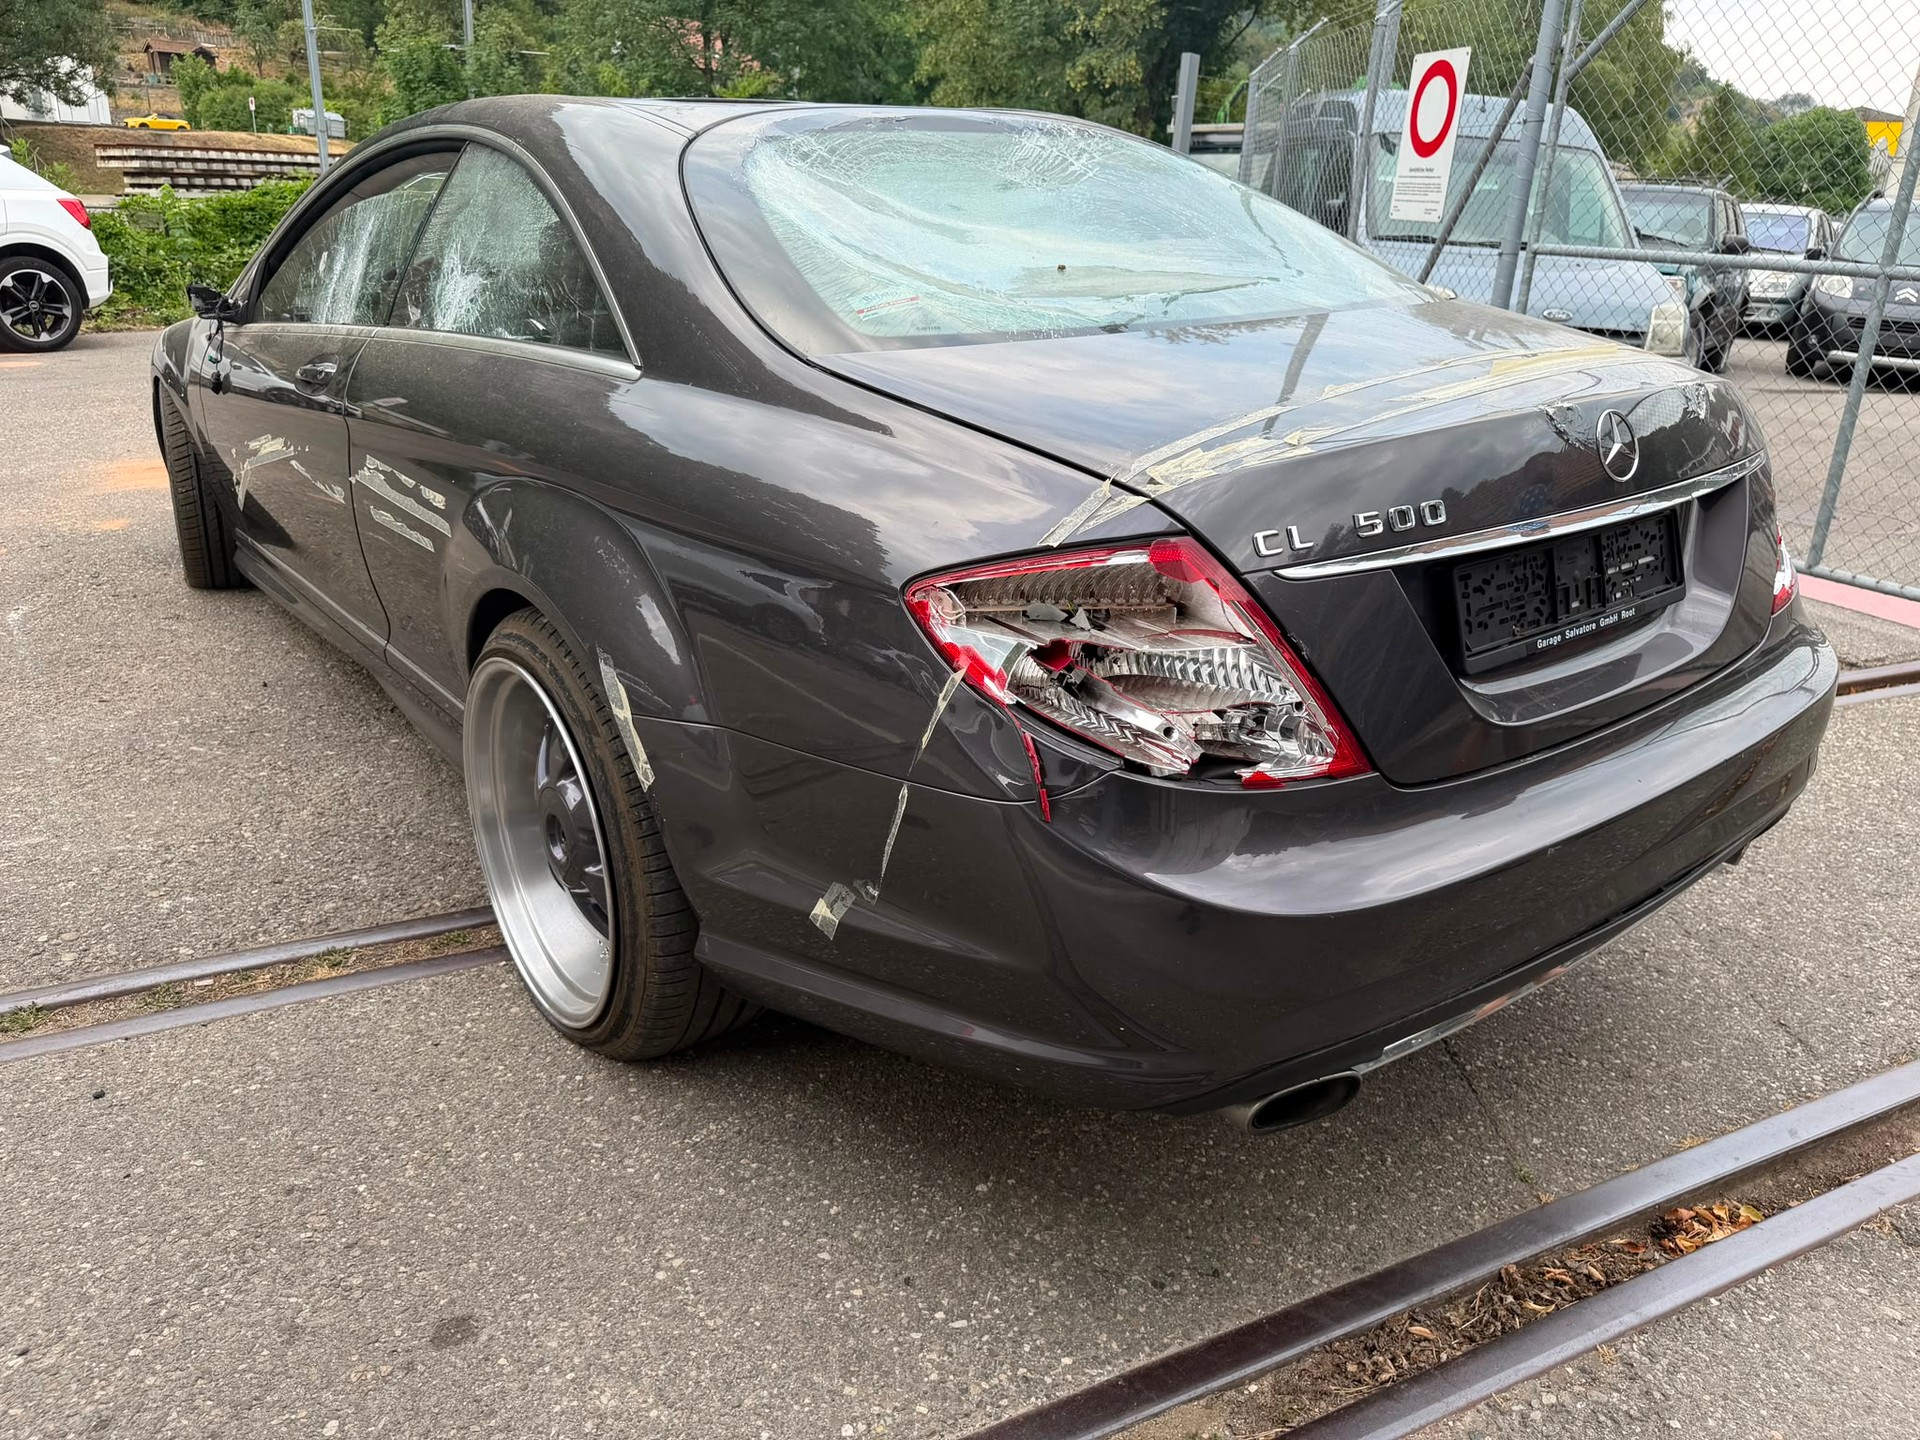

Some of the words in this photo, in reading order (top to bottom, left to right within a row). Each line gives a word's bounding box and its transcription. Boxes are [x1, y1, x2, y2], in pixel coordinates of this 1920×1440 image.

[1253, 525, 1315, 557] CL
[1353, 499, 1447, 538] 500
[1537, 634, 1562, 649] Garage
[1565, 621, 1597, 639] Salvatore
[1599, 612, 1618, 627] GmbH
[1621, 607, 1636, 620] Root
